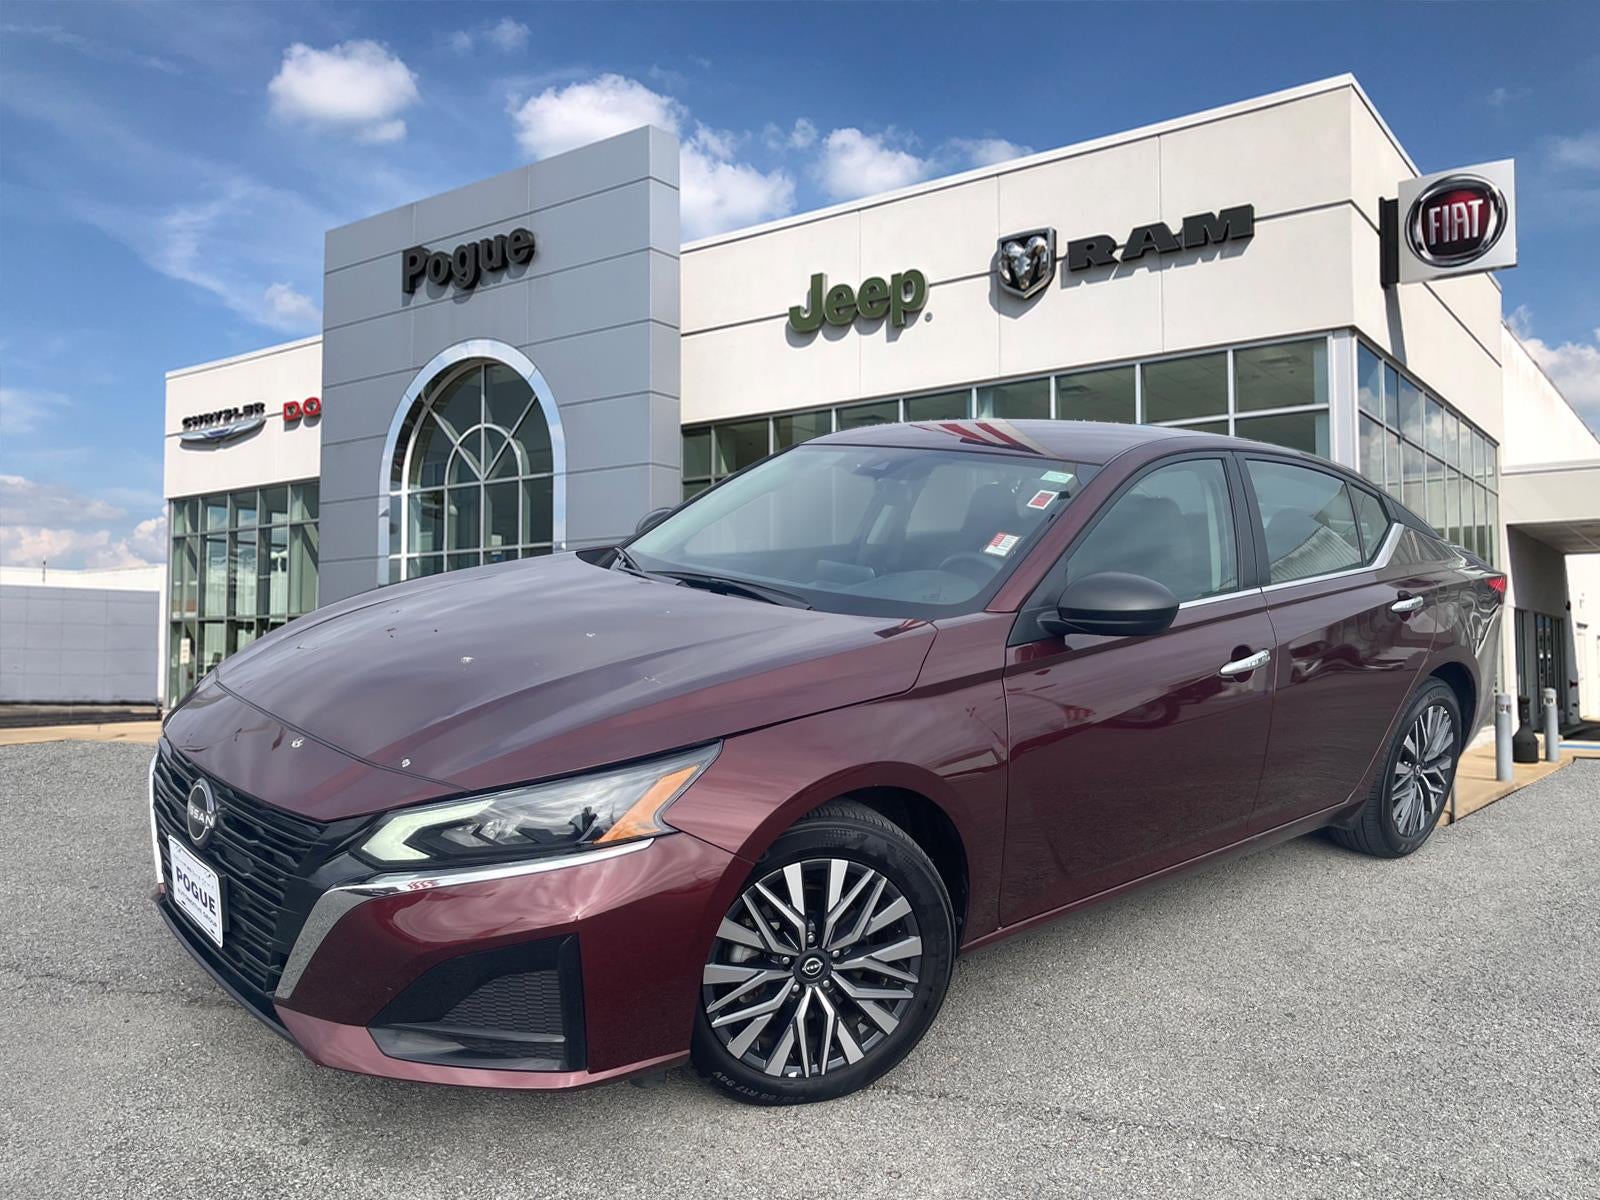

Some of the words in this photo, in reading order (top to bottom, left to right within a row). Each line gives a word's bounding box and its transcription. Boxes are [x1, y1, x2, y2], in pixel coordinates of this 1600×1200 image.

[1066, 204, 1255, 272] RAM
[1428, 199, 1484, 246] FIAT
[402, 227, 536, 294] Pogue
[788, 268, 929, 333] Jeep
[182, 402, 266, 429] CHRYSLER
[176, 866, 217, 917] POGUE
